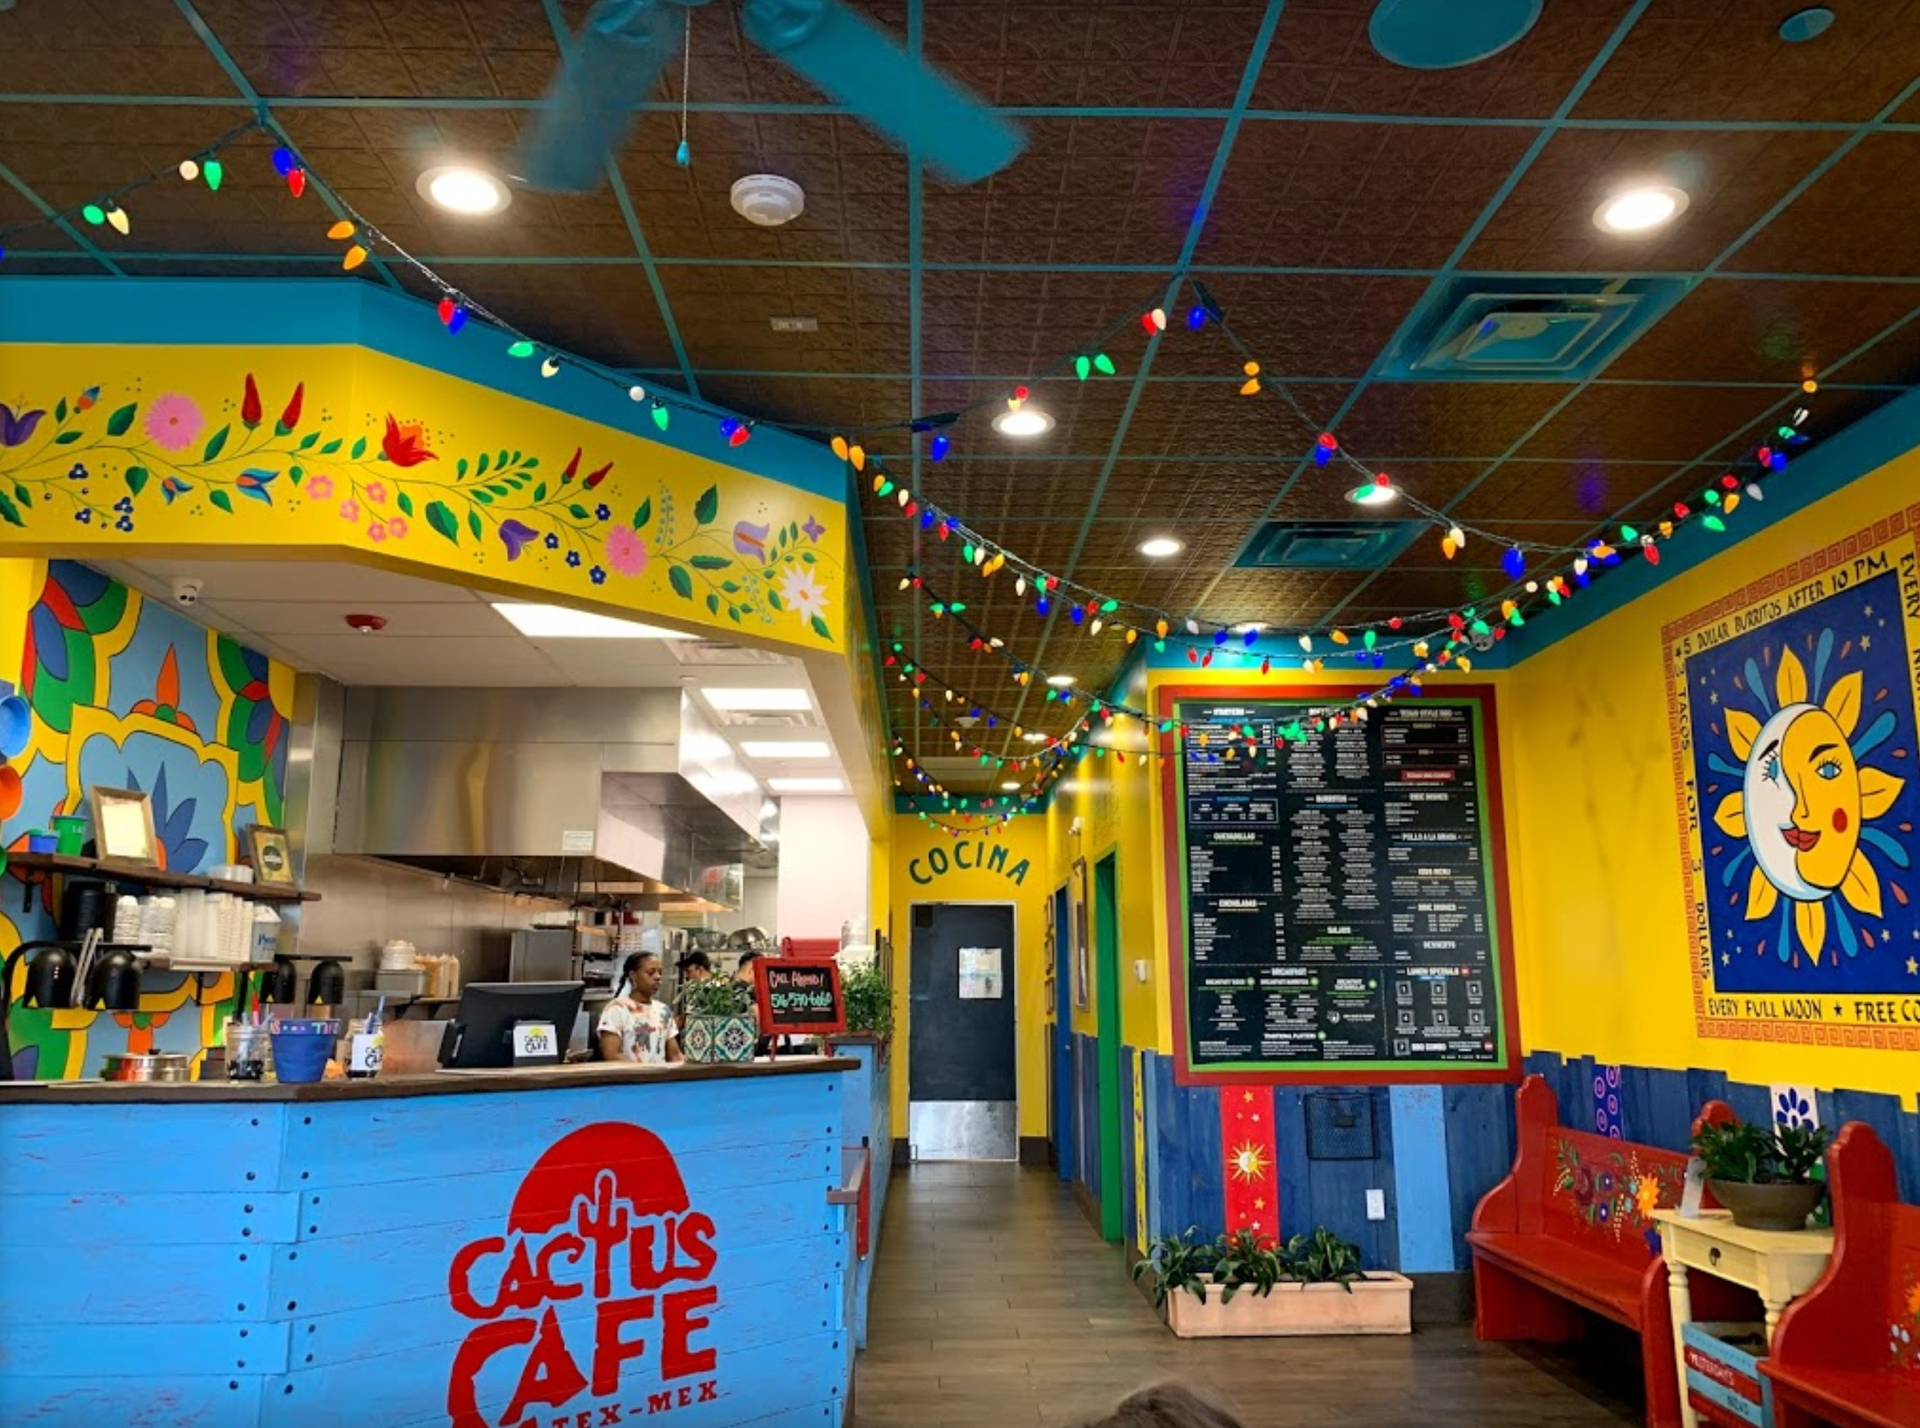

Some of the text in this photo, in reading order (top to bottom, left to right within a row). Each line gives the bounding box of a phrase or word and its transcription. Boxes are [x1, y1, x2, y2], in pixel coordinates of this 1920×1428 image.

[1684, 551, 1889, 655] 5 DOLLAR BURRITOS AFTER 10 PM
[1901, 551, 1920, 619] EVERY
[909, 840, 1030, 886] COCINA
[1677, 687, 1691, 751] TACOS
[1685, 779, 1698, 832] FOR
[1695, 902, 1711, 980] DOLLARS
[1708, 998, 1738, 1016] EVERY
[1746, 999, 1778, 1018] FULL
[1783, 999, 1823, 1019] MOON
[1854, 1001, 1897, 1023] FREE
[448, 1175, 717, 1320] CACTUS
[447, 1286, 717, 1428] CAFE
[1727, 1395, 1749, 1416] NEWS
